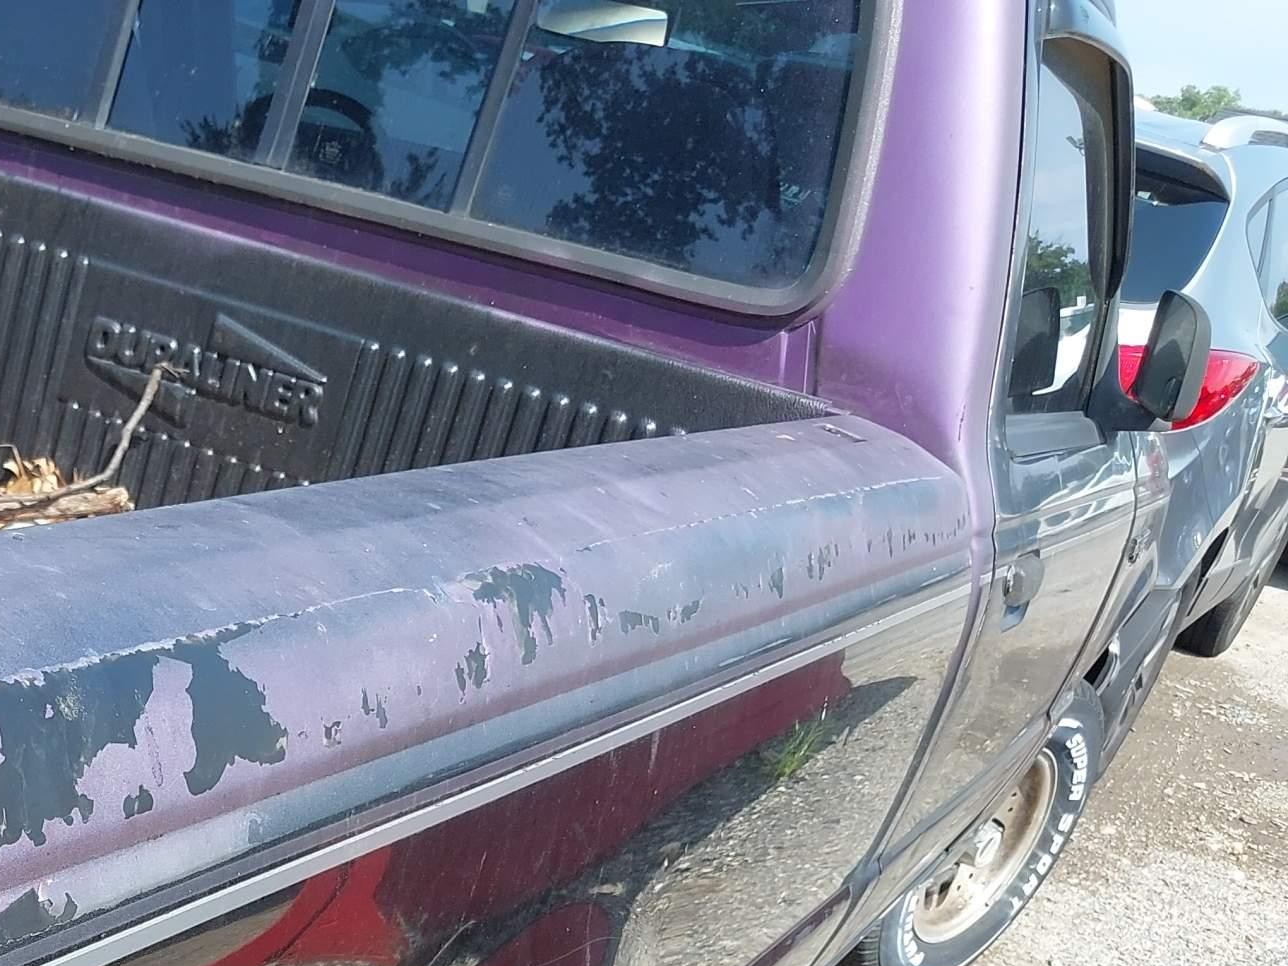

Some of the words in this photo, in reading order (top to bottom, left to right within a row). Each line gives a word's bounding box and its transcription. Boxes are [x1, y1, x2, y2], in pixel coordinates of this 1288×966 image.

[86, 314, 325, 428] DURALINER
[1065, 732, 1088, 801] SUPER
[1009, 813, 1075, 917] SPORT
